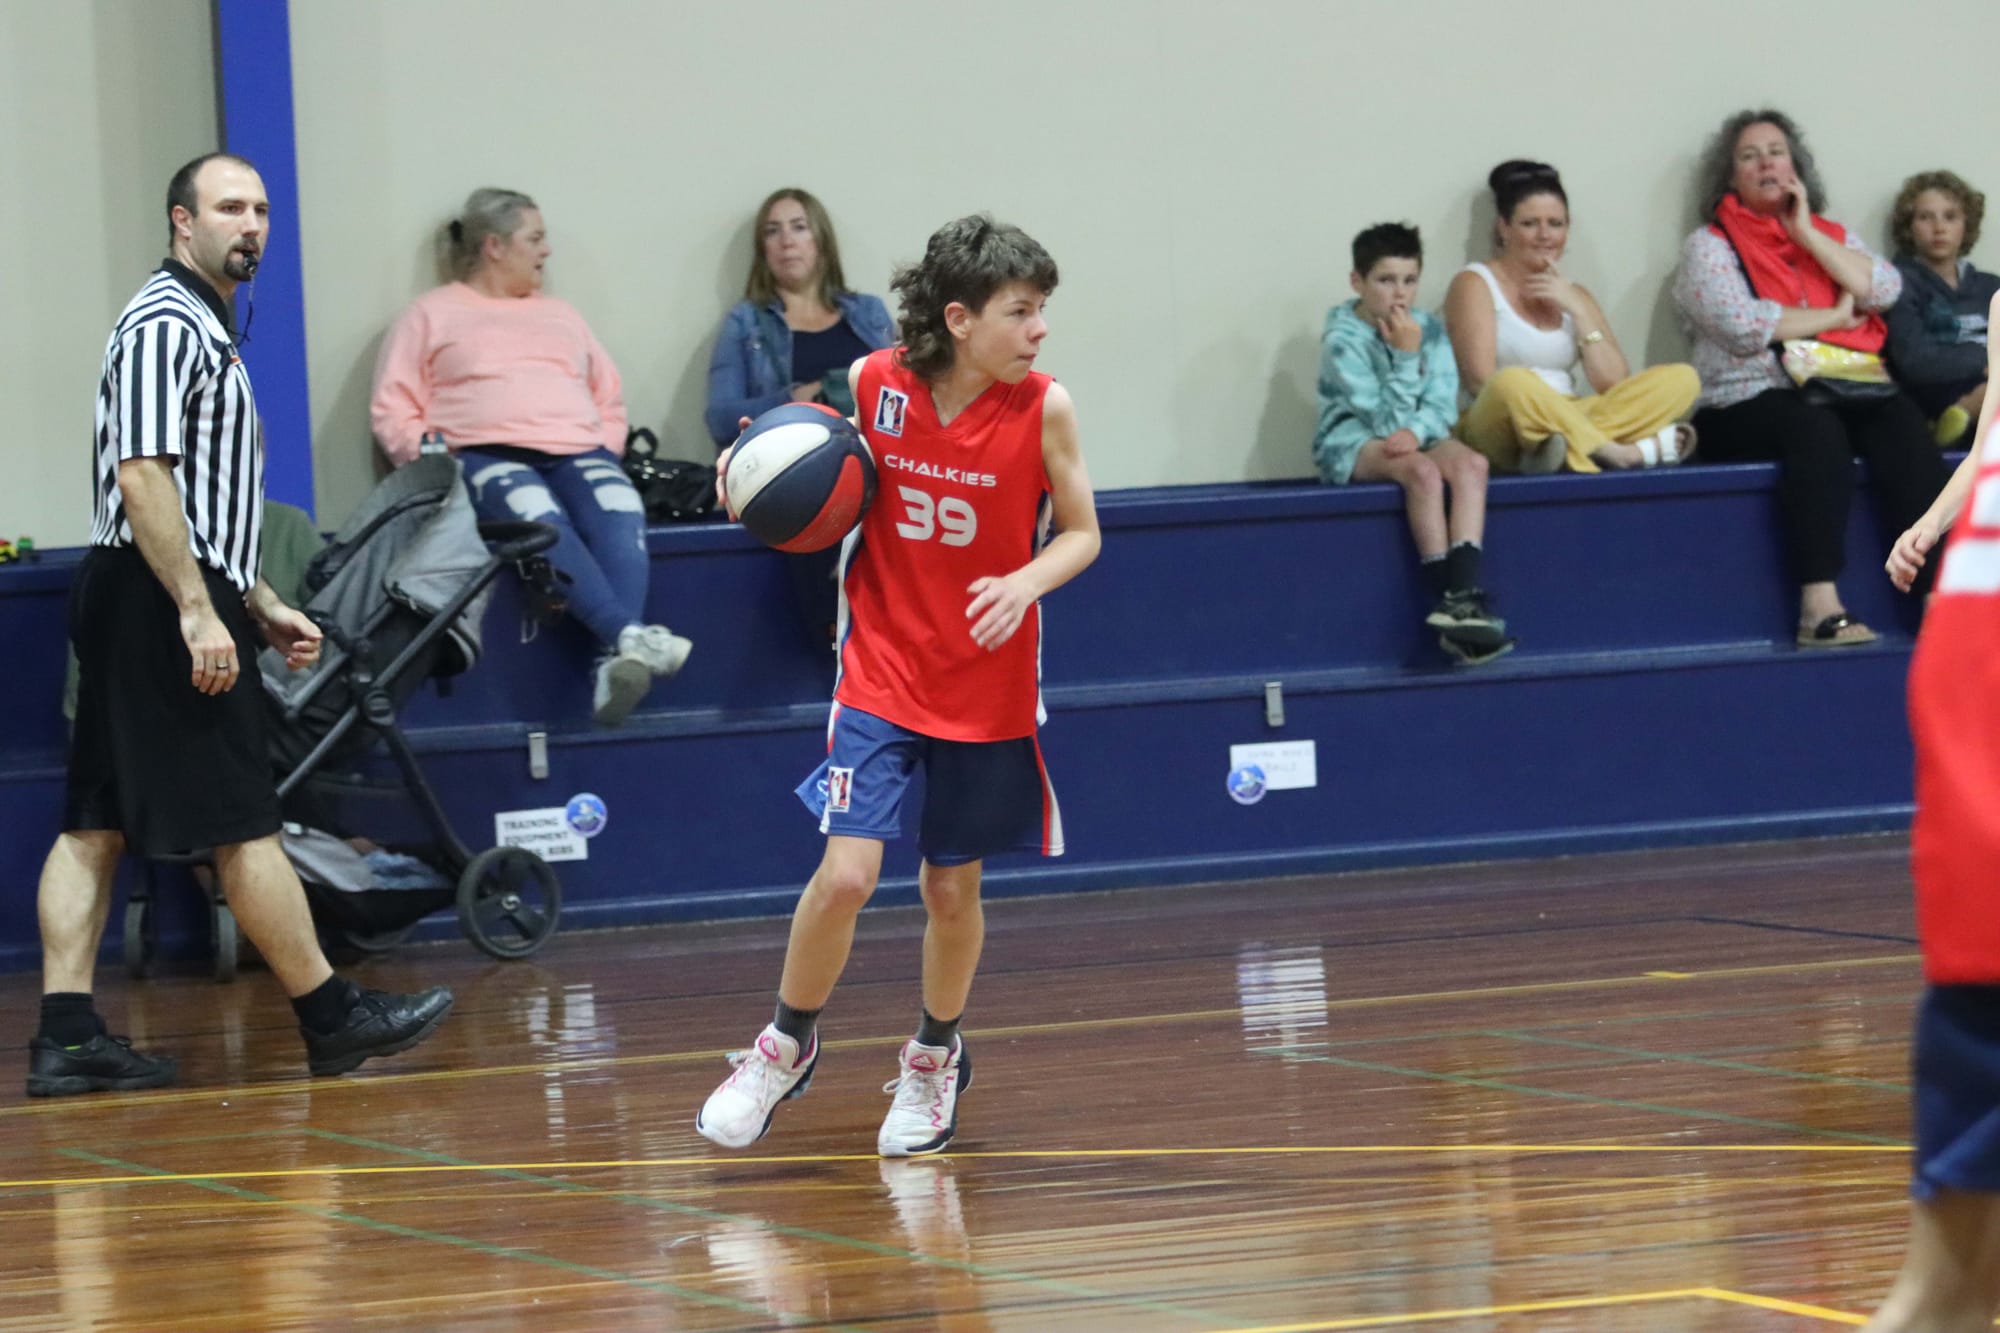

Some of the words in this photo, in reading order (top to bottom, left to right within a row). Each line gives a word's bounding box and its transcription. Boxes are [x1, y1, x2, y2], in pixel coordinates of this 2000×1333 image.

[884, 454, 997, 487] CHALKIES
[895, 485, 977, 547] 39
[503, 818, 559, 829] TRAINING
